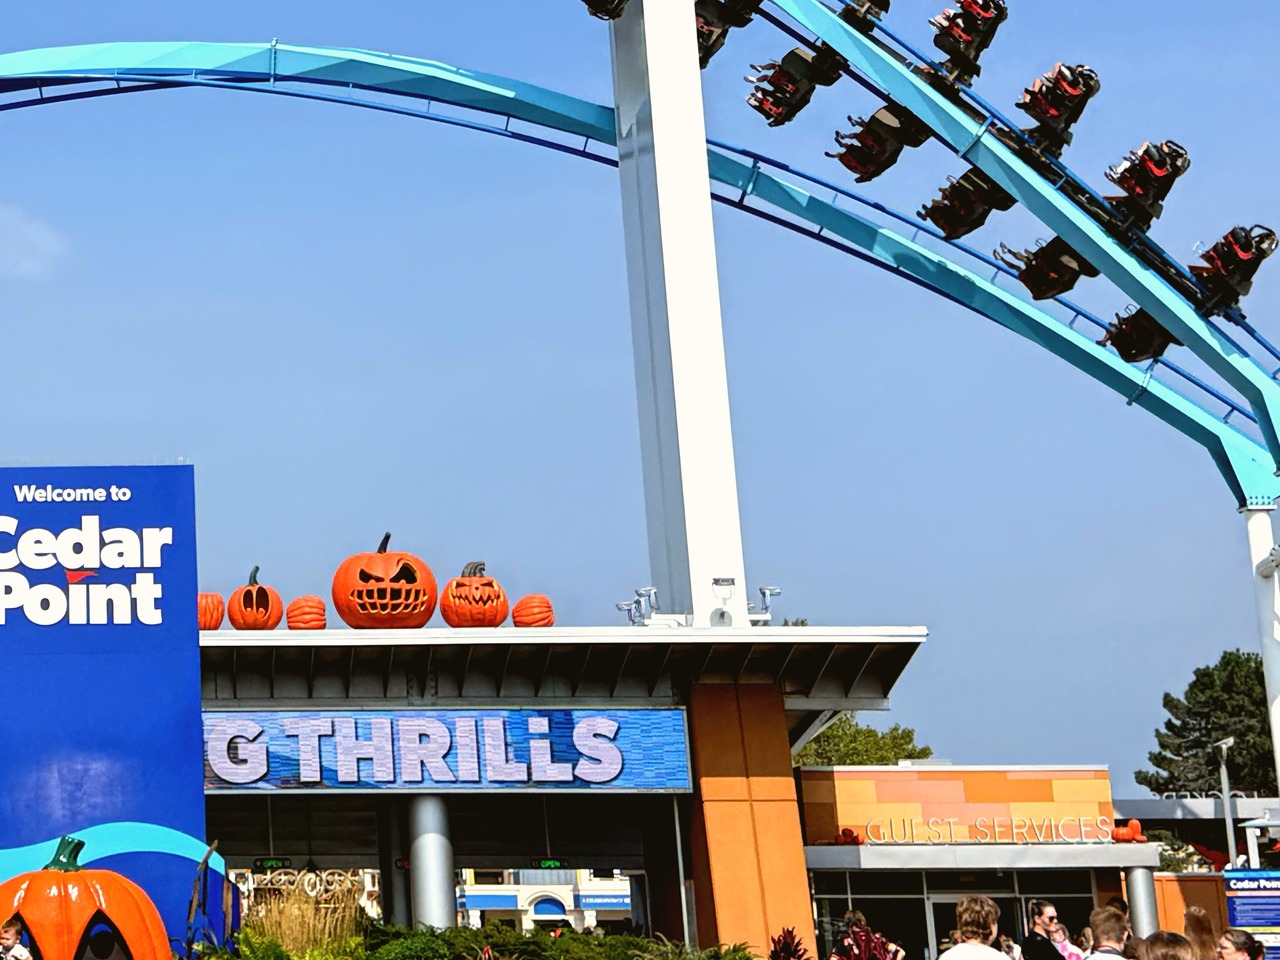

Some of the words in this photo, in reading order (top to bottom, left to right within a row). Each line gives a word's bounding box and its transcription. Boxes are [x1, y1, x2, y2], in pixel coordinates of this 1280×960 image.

[14, 484, 106, 502] Welcome
[109, 484, 132, 502] to
[281, 717, 622, 783] THRILLS
[865, 817, 959, 844] GUEST
[975, 816, 1113, 844] SERVICES
[263, 859, 283, 868] OPEN
[540, 859, 560, 868] OPEN
[1229, 879, 1259, 889] Cedar
[1259, 879, 1280, 889] Poin
